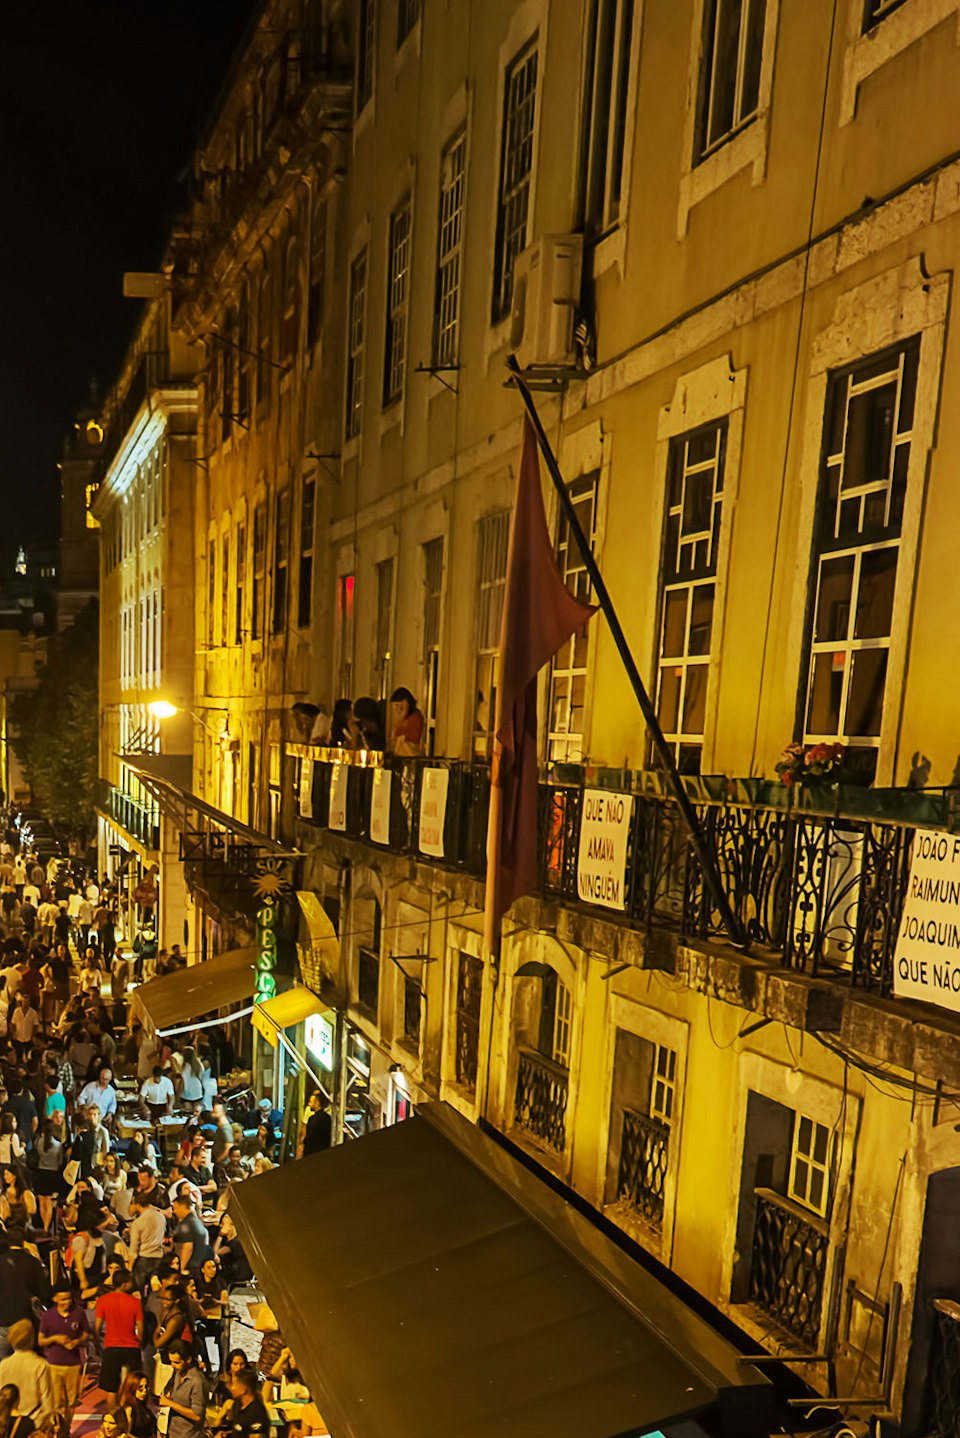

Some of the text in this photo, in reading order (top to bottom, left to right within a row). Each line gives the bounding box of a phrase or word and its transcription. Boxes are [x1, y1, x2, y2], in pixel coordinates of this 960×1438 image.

[585, 795, 625, 824] QUE NÃO
[917, 832, 948, 860] JOÃO
[580, 871, 620, 903] NINGUÉM
[898, 957, 960, 993] QUE NÃO
